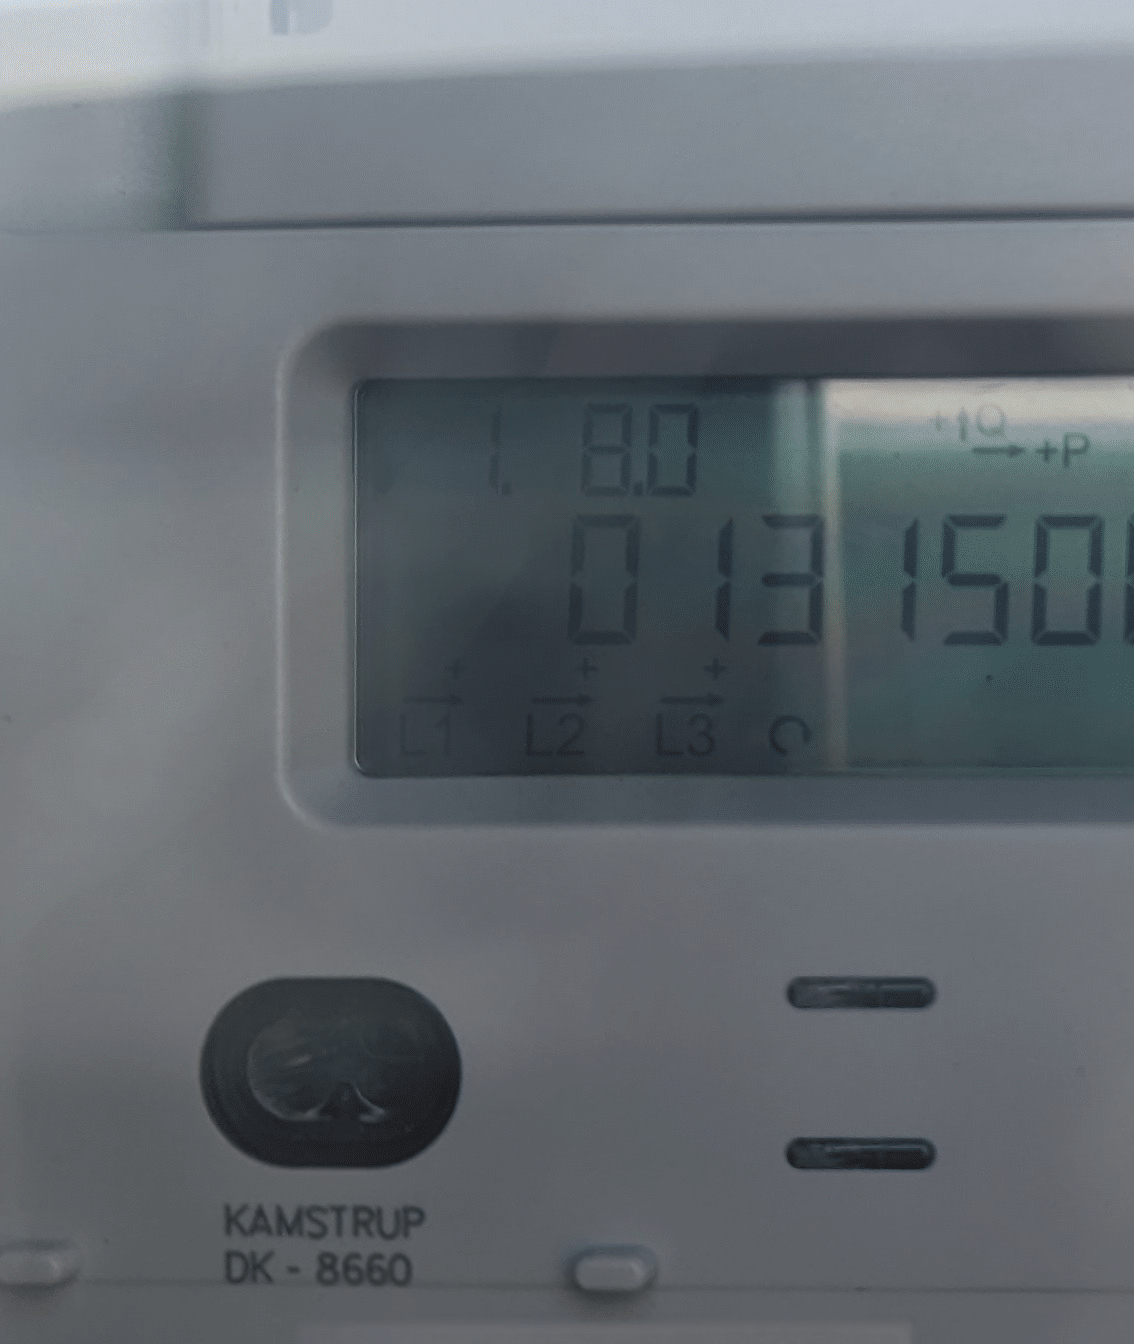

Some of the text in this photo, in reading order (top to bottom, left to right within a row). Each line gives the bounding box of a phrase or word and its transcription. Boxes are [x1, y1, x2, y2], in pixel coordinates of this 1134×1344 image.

[401, 713, 454, 756] L1
[525, 713, 587, 757] L2
[654, 713, 717, 757] L3
[222, 1203, 427, 1241] KAMSTRUP
[222, 1249, 276, 1286] DK
[315, 1251, 414, 1288] 8660
